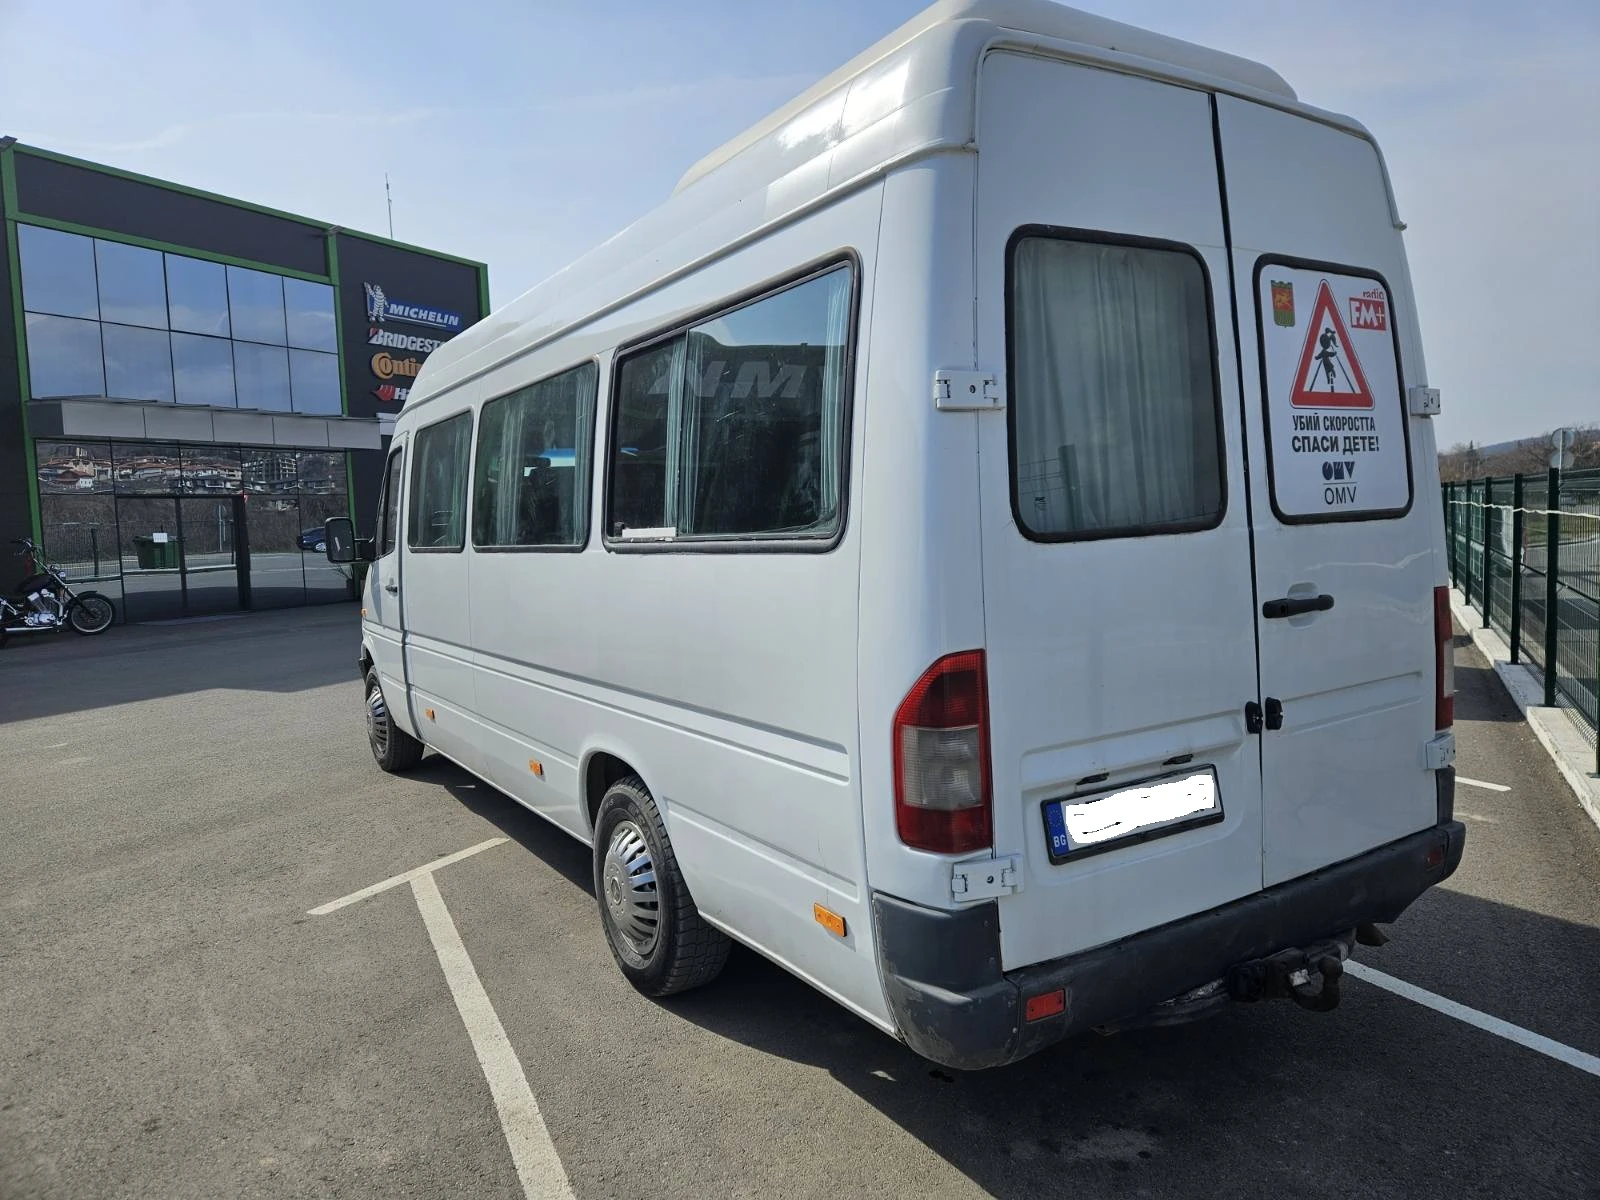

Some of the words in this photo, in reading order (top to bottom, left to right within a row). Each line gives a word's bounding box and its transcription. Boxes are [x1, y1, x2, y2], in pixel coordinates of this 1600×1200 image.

[1362, 289, 1384, 300] radio
[389, 303, 459, 326] MICHELIN
[1350, 300, 1385, 328] FM+
[368, 328, 445, 353] BRIDGEST
[1292, 412, 1321, 431] УБИЙ
[1323, 415, 1376, 432] СКОРОСТТА
[1291, 435, 1340, 453] СПАСИ
[1342, 436, 1380, 456] ДЕТЕ!
[1324, 486, 1357, 505] OMV
[1053, 835, 1067, 848] BG
